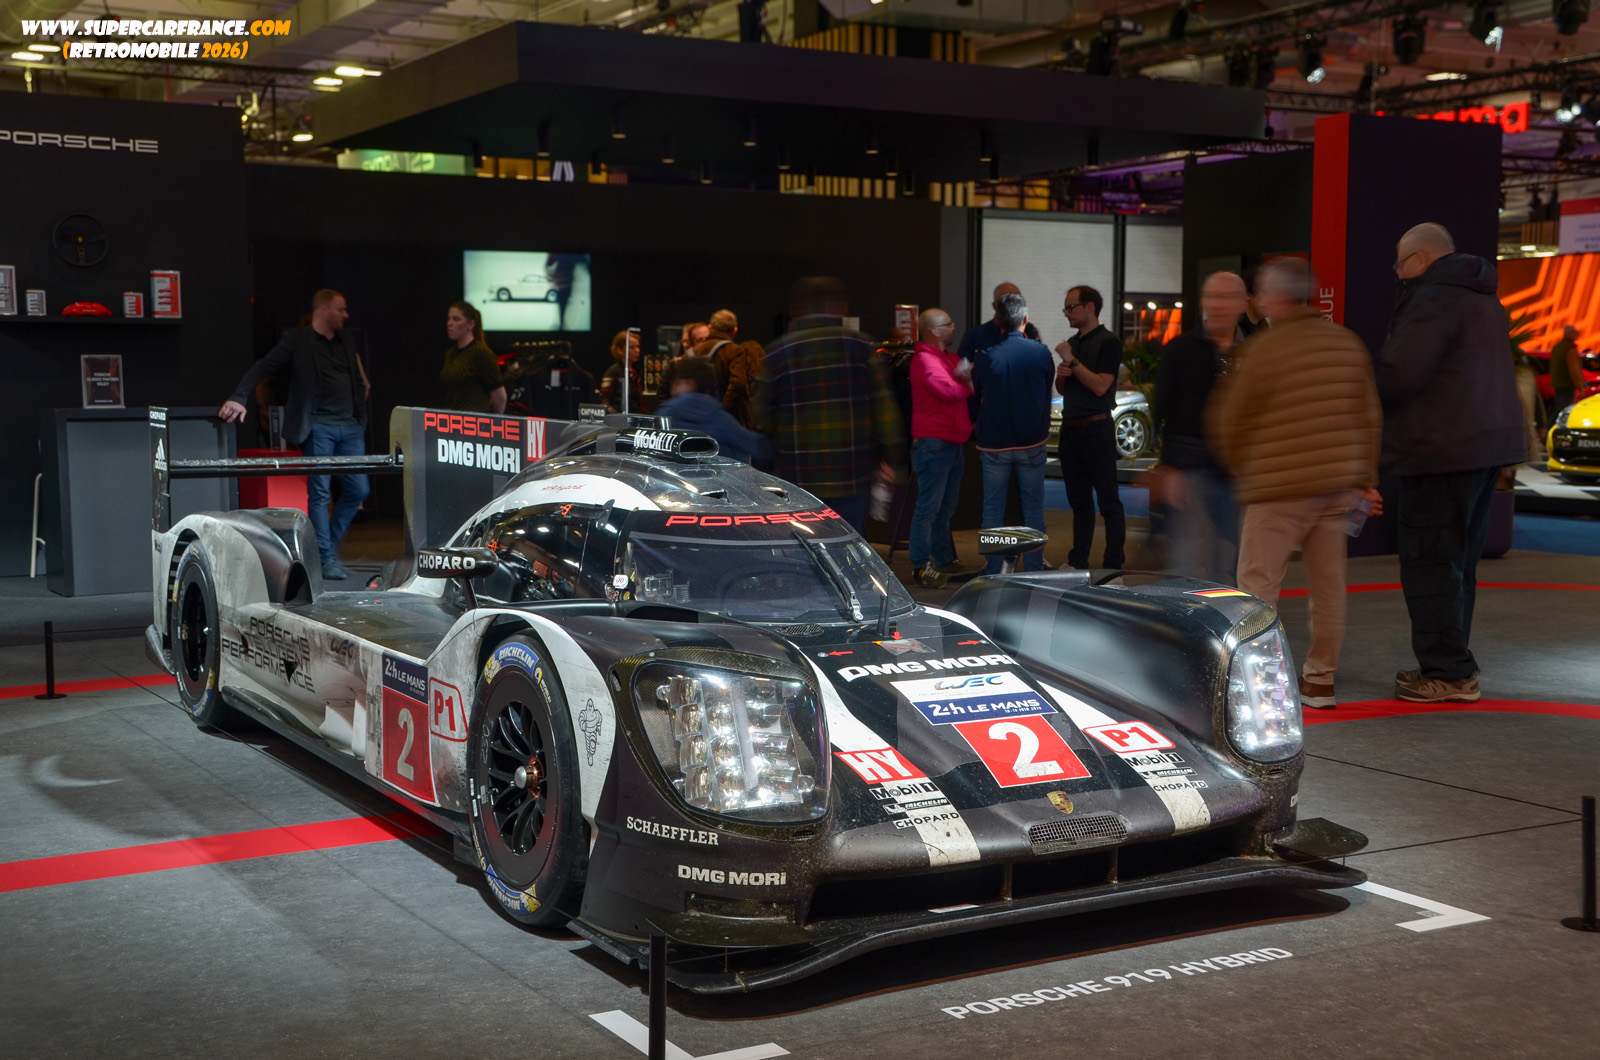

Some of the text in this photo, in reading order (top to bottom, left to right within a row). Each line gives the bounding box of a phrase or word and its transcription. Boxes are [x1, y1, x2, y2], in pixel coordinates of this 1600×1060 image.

[424, 412, 521, 441] PORSCHE
[527, 419, 545, 459] HY
[633, 429, 663, 450] Mobil
[437, 438, 521, 474] DMG MORI
[665, 507, 842, 527] PORSCHE
[980, 535, 1018, 545] CHOPARD
[418, 554, 476, 571] CHOPARD
[250, 616, 310, 656] PORSCHE
[499, 646, 535, 669] MICHELIN
[385, 658, 426, 691] 24h LE MANS
[837, 662, 928, 682] DMG
[934, 675, 1004, 691] WEC
[434, 689, 457, 732] P1
[928, 699, 1041, 717] 24h LE MANS
[397, 707, 415, 782] 2
[1100, 726, 1160, 748] P1
[989, 721, 1064, 778] 2
[840, 750, 914, 781] HY
[1125, 756, 1169, 768] Mobil
[870, 785, 922, 800] Mobil
[1153, 781, 1207, 792] CHOPARD
[904, 798, 948, 809] MICHELIN
[626, 816, 719, 846] SCHAEFFLER
[895, 813, 960, 828] CHOPARD
[677, 864, 787, 886] DMG MORI
[941, 947, 1294, 1020] PORSCHE 919 HYBRID
